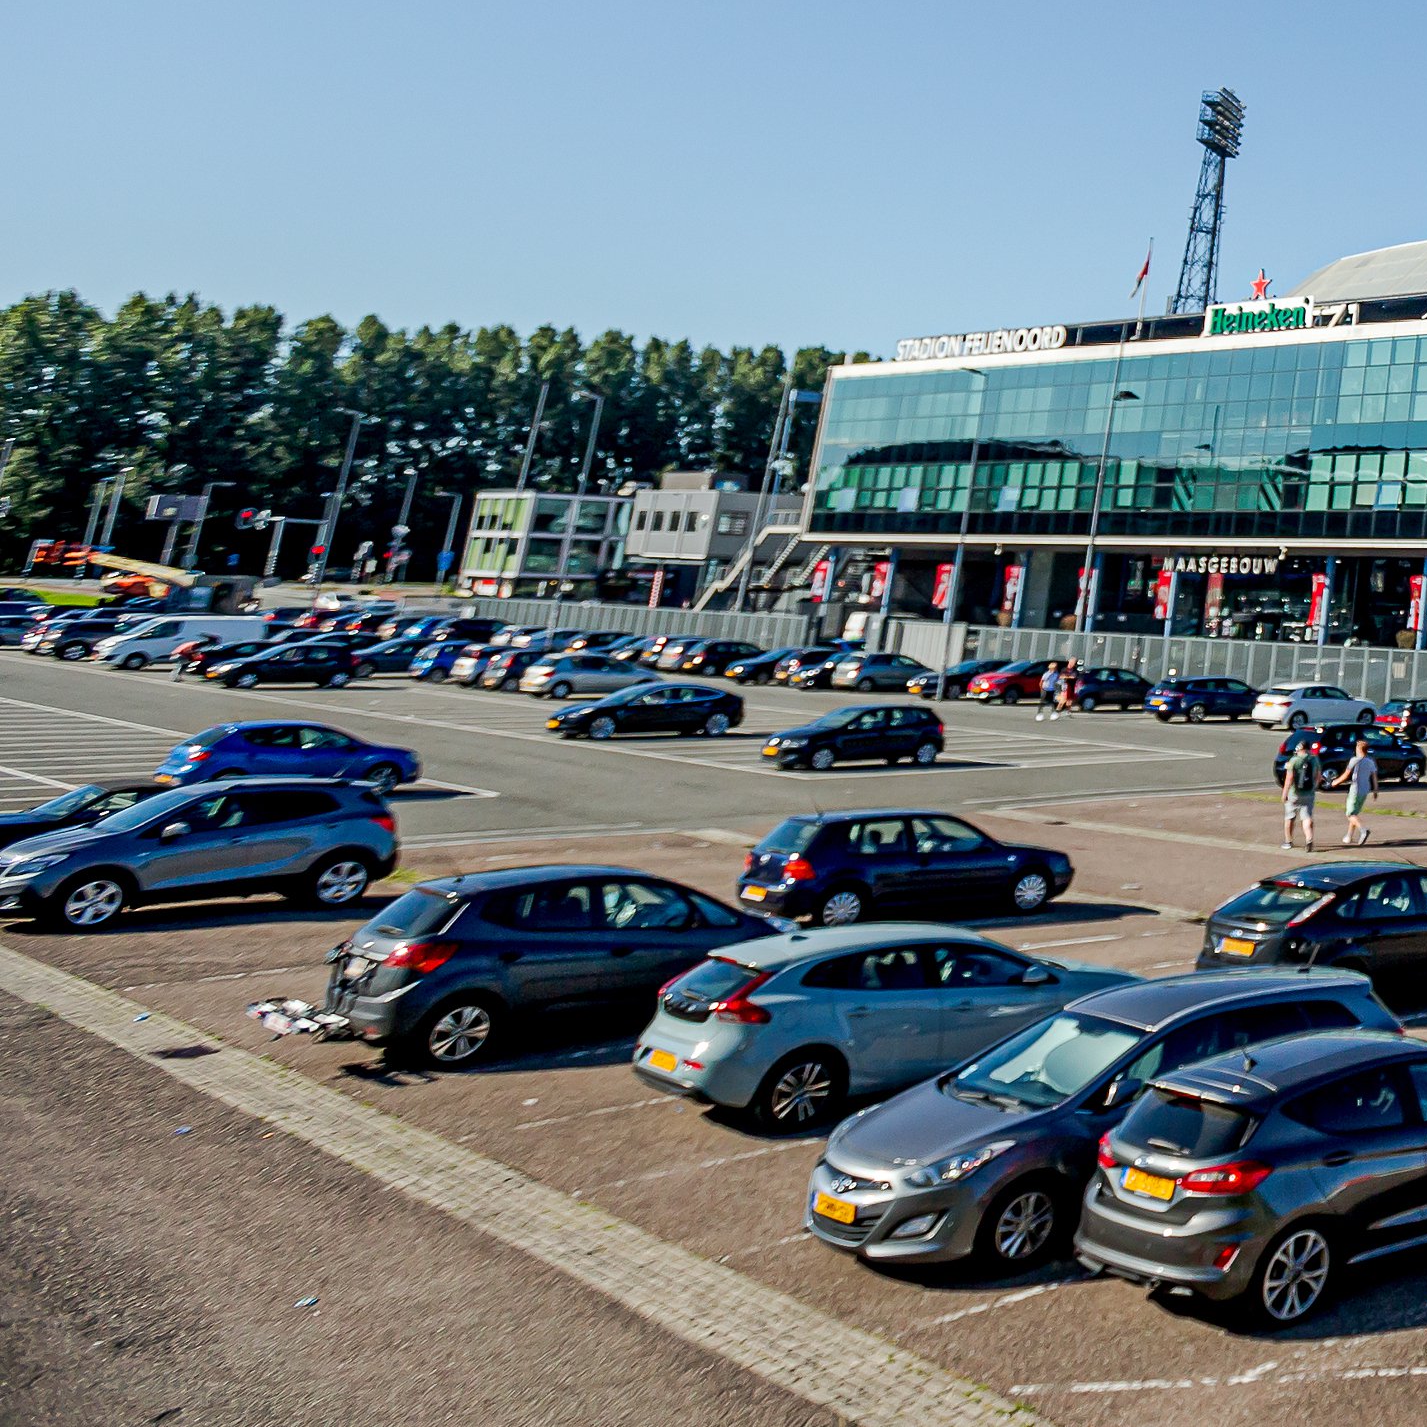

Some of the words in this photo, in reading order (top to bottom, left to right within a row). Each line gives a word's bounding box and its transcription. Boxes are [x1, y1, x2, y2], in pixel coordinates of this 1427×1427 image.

[1210, 303, 1306, 335] Heineken
[896, 335, 963, 362] STADION
[1163, 556, 1278, 575] MAASGEBOUW
